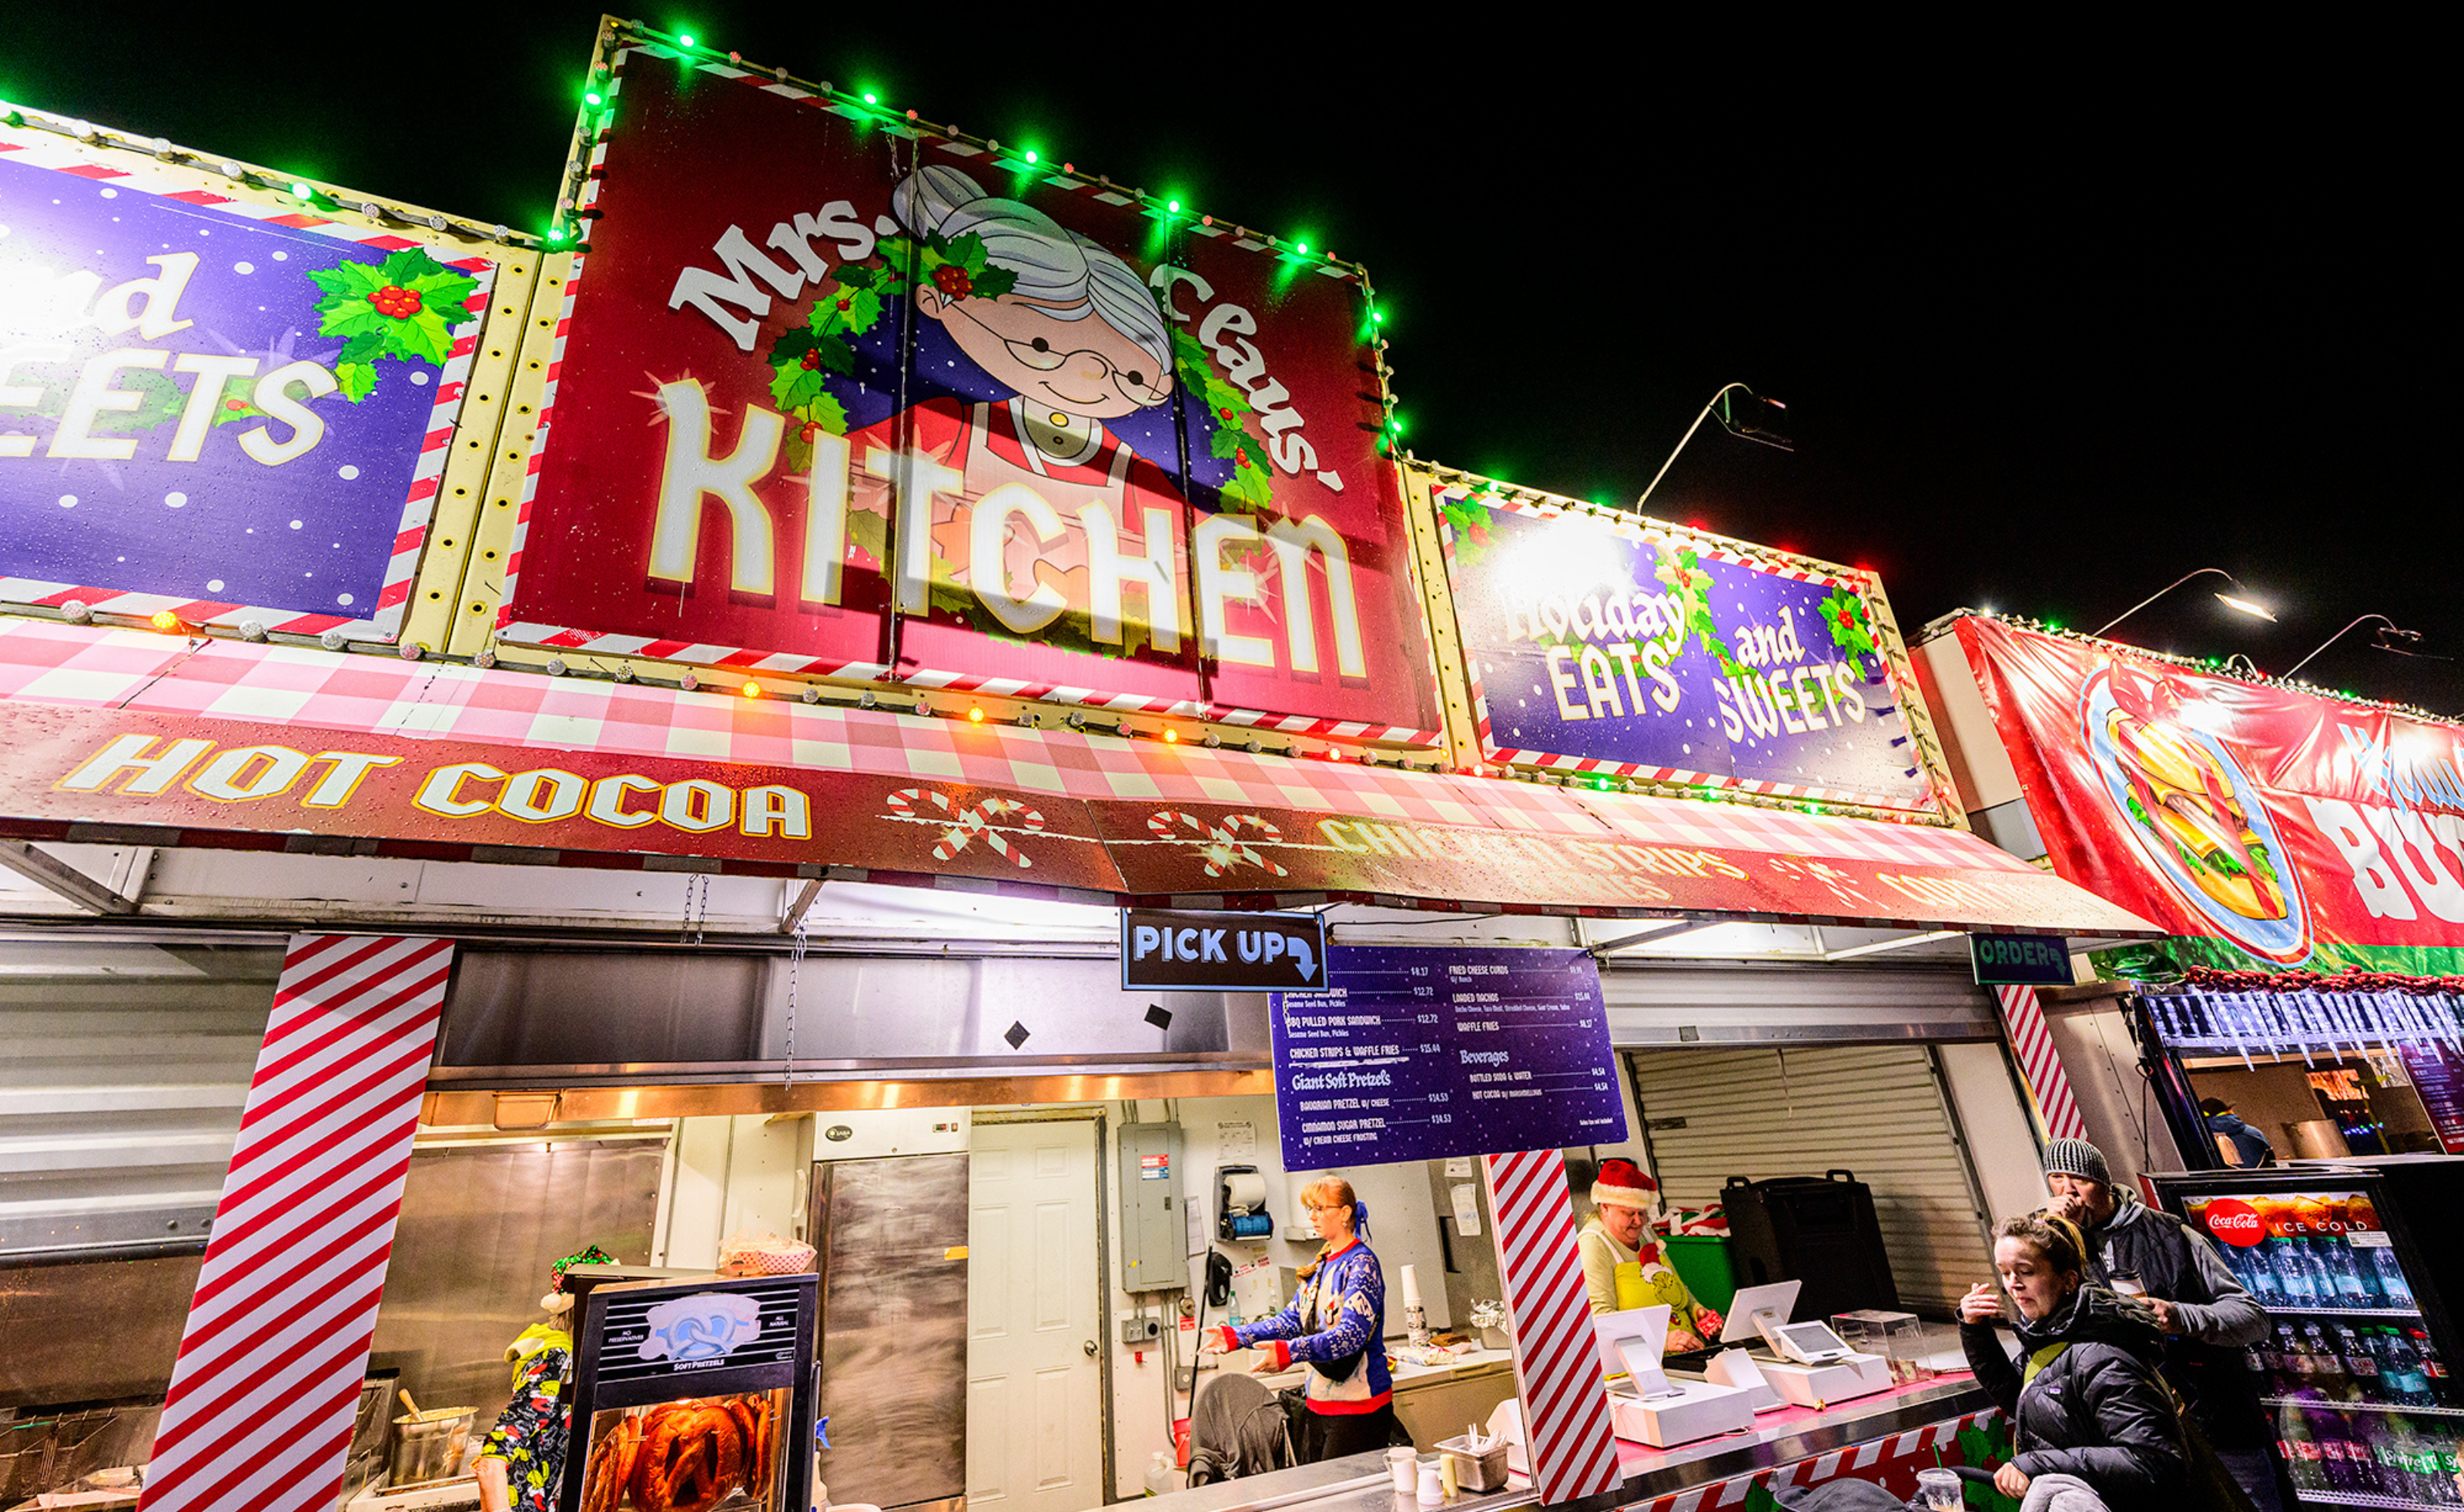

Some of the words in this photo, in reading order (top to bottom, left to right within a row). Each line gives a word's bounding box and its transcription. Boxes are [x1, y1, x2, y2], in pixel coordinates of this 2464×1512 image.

[668, 200, 899, 351] Mrs.
[648, 377, 1368, 678] KITCHEN
[1733, 605, 1806, 669] and
[1546, 641, 1681, 722] EATS
[1712, 661, 1866, 744] SWEETS
[52, 733, 404, 810] HOT
[411, 763, 813, 840] COCOA
[1565, 840, 1749, 881] STRIPS
[1133, 925, 1228, 963] PICK
[1237, 930, 1286, 964] UP
[1979, 940, 2051, 966] ORDER
[1448, 965, 1466, 975] FRIED
[1467, 965, 1489, 975] CHEESE
[1489, 965, 1509, 975] CURDS
[1414, 987, 1434, 996] $12.72
[1452, 993, 1475, 1003] LOADED
[1475, 993, 1500, 1002] NACHOS
[1301, 1016, 1327, 1027] PULLED
[1327, 1015, 1347, 1027] PORK
[1347, 1015, 1381, 1026] SANDWICH
[1418, 1014, 1438, 1024] $12.72
[1457, 1021, 1481, 1032] WAFFLE
[1481, 1021, 1500, 1031] FRIES
[1290, 1048, 1319, 1059] CHICKEN
[1320, 1046, 1344, 1058] STRIPS
[1344, 1047, 1352, 1057] &
[1353, 1045, 1380, 1057] WAFFLE
[1381, 1044, 1400, 1055] FRIES
[1459, 1049, 1509, 1068] Beverages
[1292, 1072, 1325, 1091] Giant
[1325, 1070, 1348, 1089] Soft
[1348, 1069, 1391, 1088] Pretzels
[1469, 1073, 1492, 1083] BOTTLED
[1483, 1089, 1501, 1099] COCOA
[1300, 1100, 1332, 1112] BAVARIAN
[1333, 1098, 1361, 1110] PRETZEL
[1371, 1098, 1391, 1108] CHEESE
[1301, 1121, 1336, 1133] CINNAMON
[1337, 1119, 1358, 1131] SUGAR
[1359, 1118, 1386, 1129] PRETZEL
[1314, 1135, 1332, 1145] CREAM
[1333, 1133, 1352, 1143] CHEESE
[1353, 1132, 1378, 1142] FROSTING
[2208, 1213, 2259, 1230] Coca-Cola
[2275, 1221, 2307, 1232] ICE
[2316, 1221, 2368, 1232] COLD
[608, 1334, 644, 1343] PRESERVATIVES
[674, 1362, 691, 1371] SOFT
[692, 1359, 725, 1370] PRETZELS
